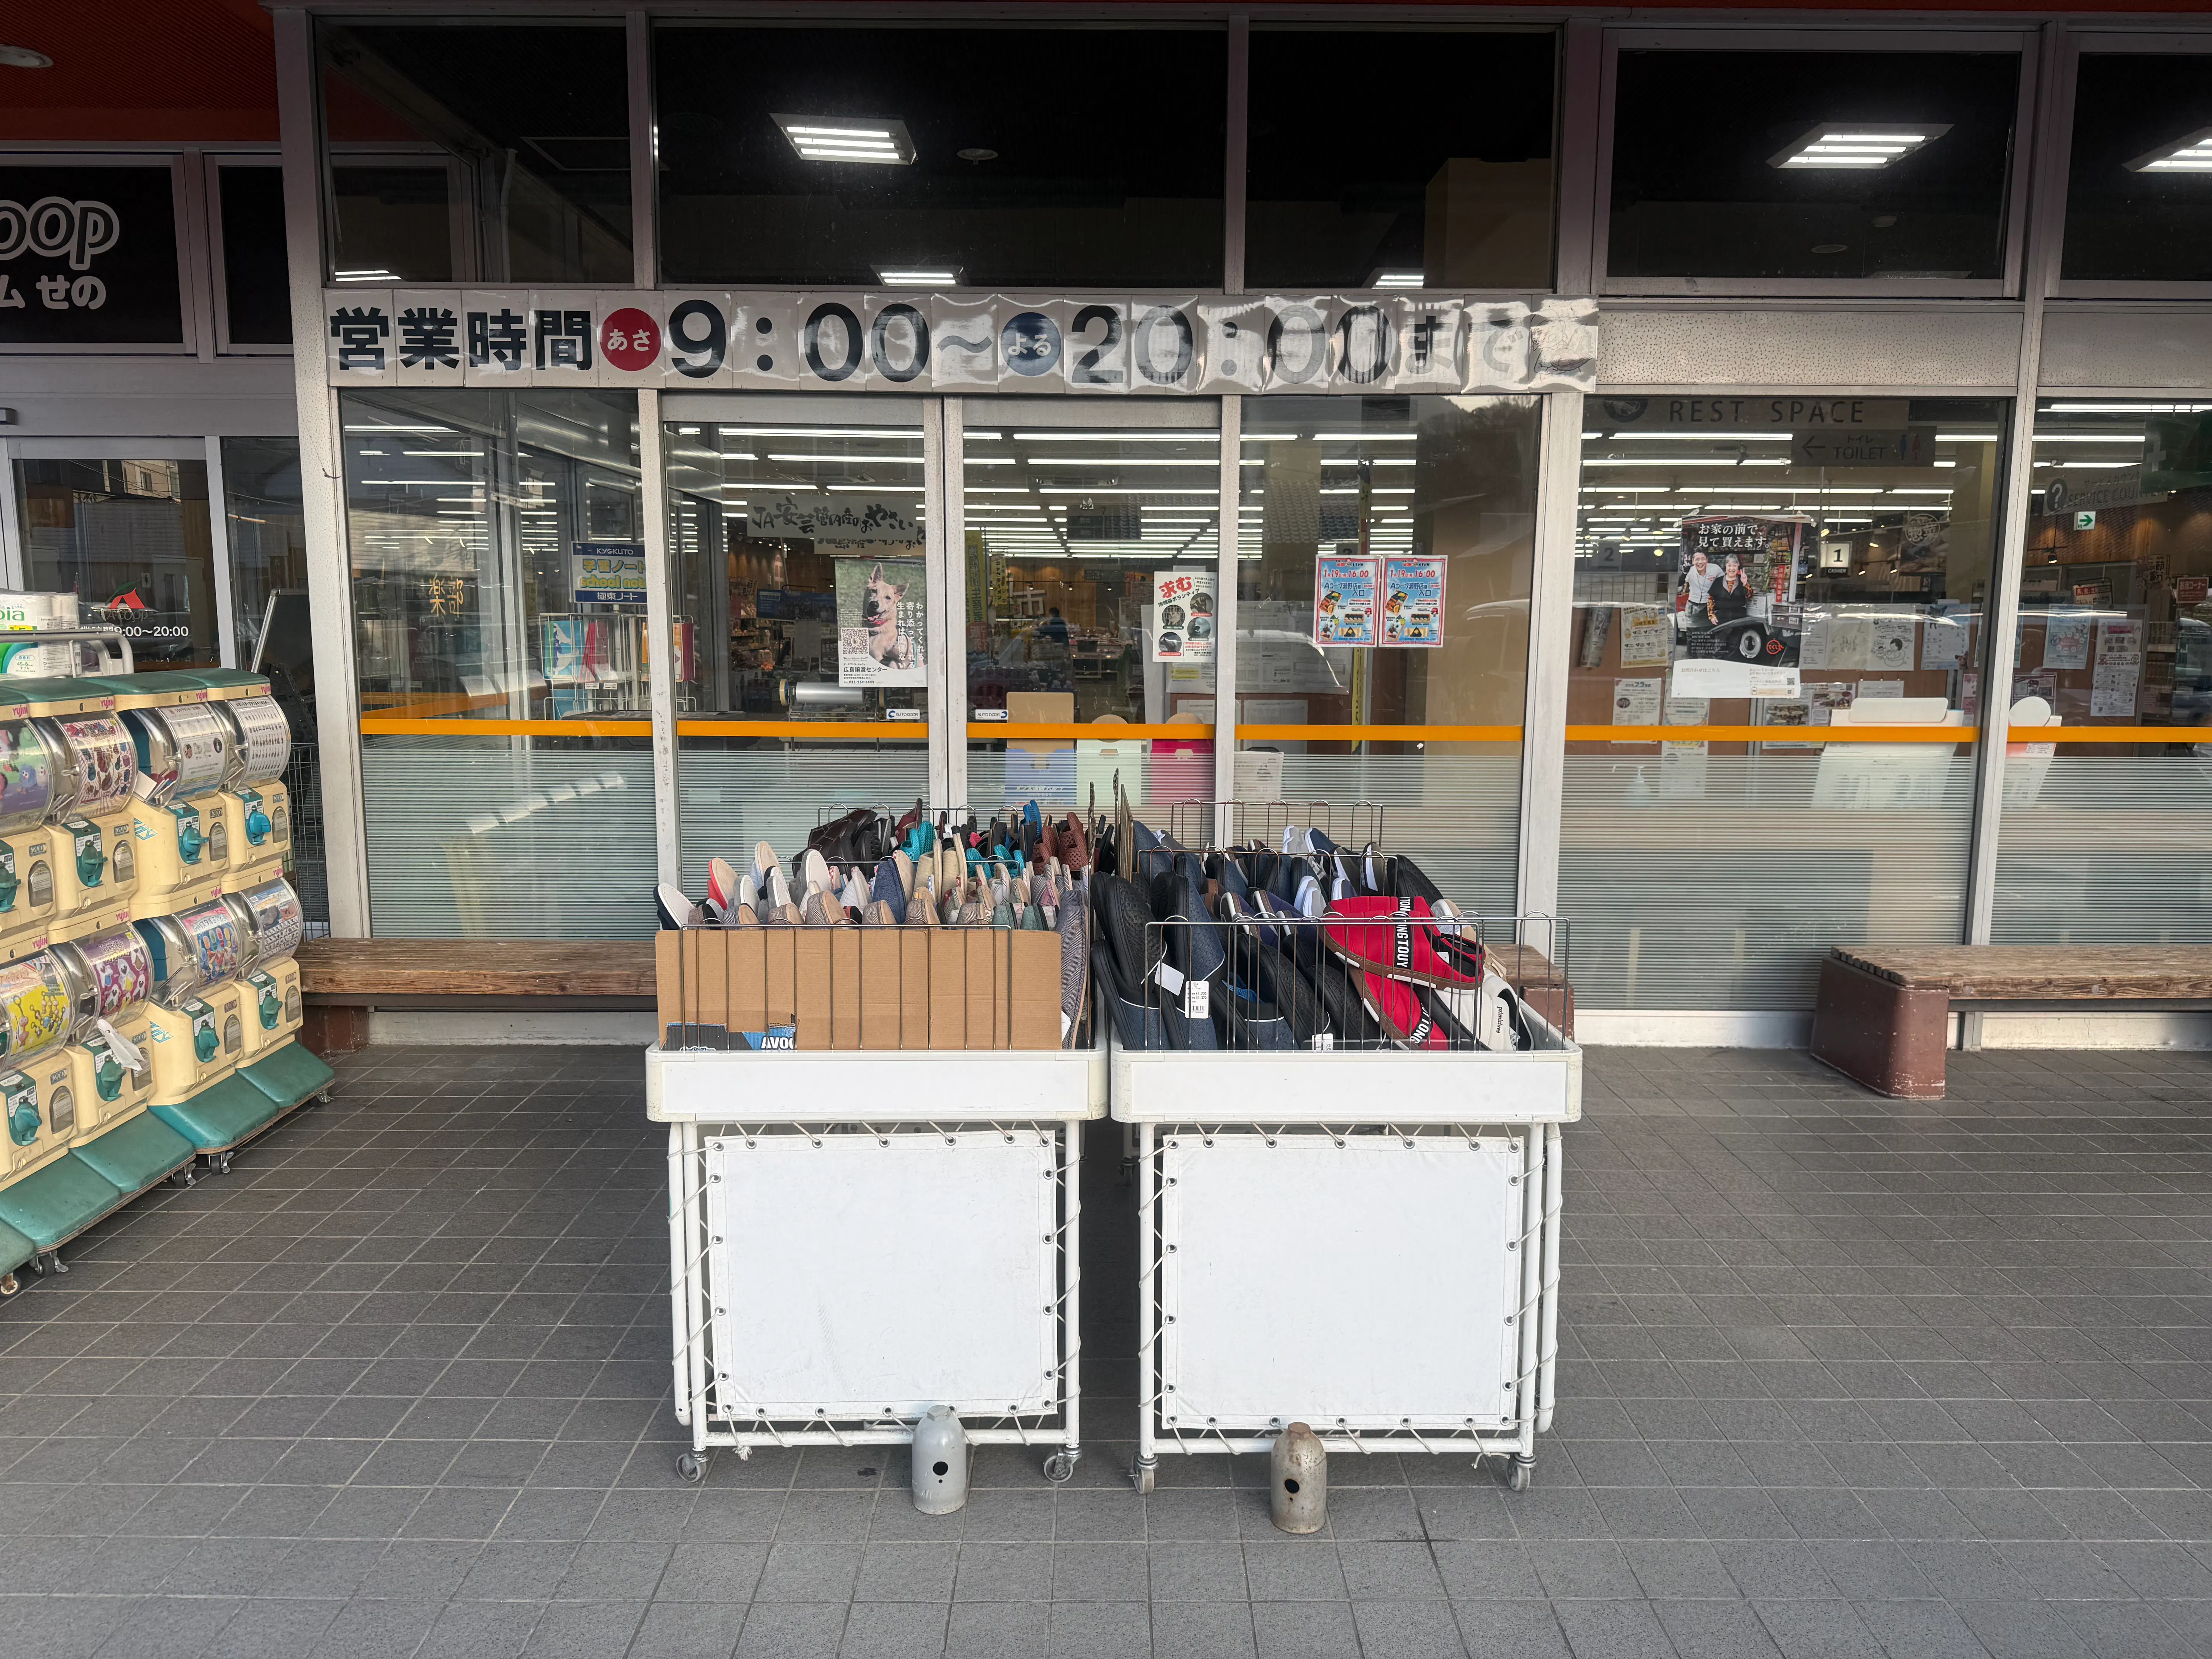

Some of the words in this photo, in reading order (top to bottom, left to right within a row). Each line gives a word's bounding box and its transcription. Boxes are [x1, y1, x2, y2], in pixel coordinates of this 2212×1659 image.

[36, 275, 106, 309] せの
[330, 307, 592, 371] 営業時間
[607, 327, 652, 353] あさ
[1007, 329, 1053, 359] よる
[1071, 304, 1523, 385] 20:00まで
[1669, 400, 1745, 423] REST
[1771, 400, 1863, 423] SPACE
[1848, 434, 1873, 444] トイレ
[1833, 446, 1887, 460] TOILET
[2068, 489, 2109, 507] SERVICE
[1698, 523, 1762, 535] お家の前で、
[1698, 536, 1769, 548] 見て買えます。
[1604, 547, 1614, 561] 2
[1833, 548, 1843, 562] 1
[580, 574, 621, 589] school
[623, 577, 646, 589] not
[1159, 577, 1192, 599] 求む
[597, 592, 638, 600] 極東ノート
[915, 603, 925, 660] わかってくれる
